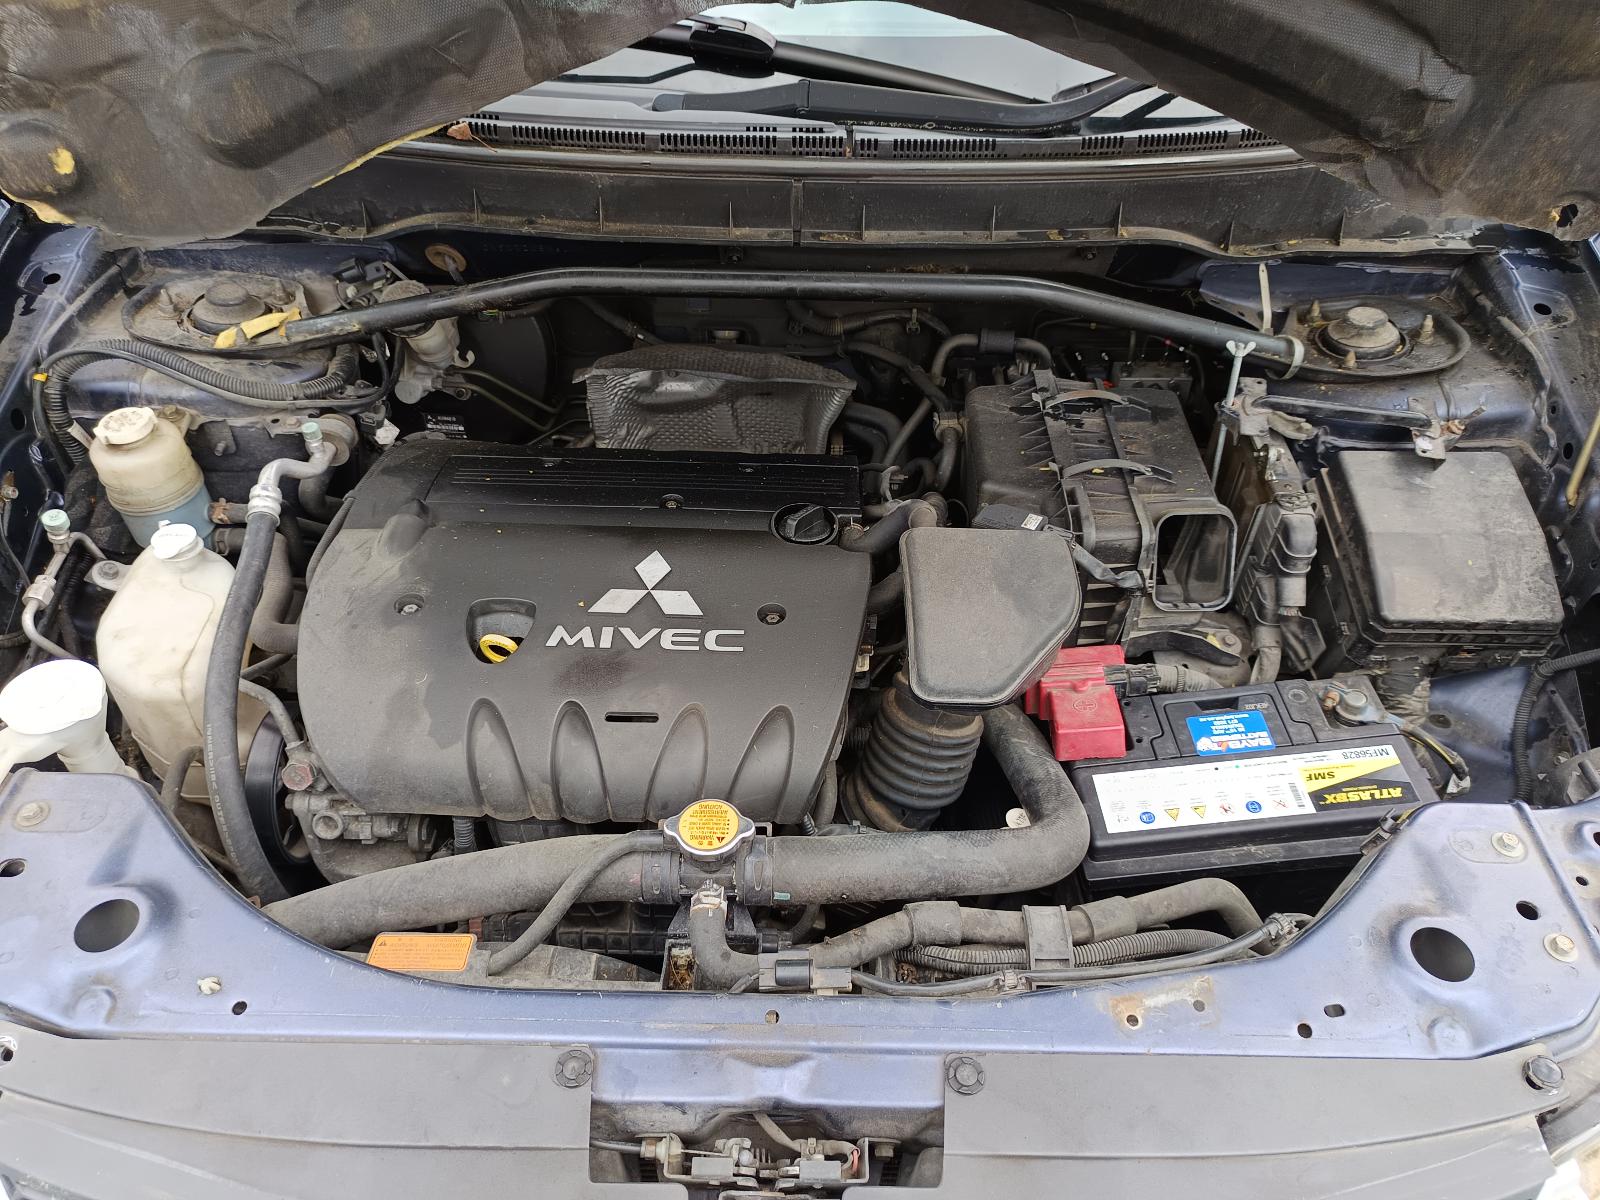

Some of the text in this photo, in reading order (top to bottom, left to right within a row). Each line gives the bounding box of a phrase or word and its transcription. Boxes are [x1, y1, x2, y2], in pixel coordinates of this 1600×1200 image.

[545, 625, 745, 652] MIVEC
[1341, 748, 1390, 760] MF56828
[1305, 771, 1335, 782] SMF
[1323, 787, 1403, 804] ATLASBX
